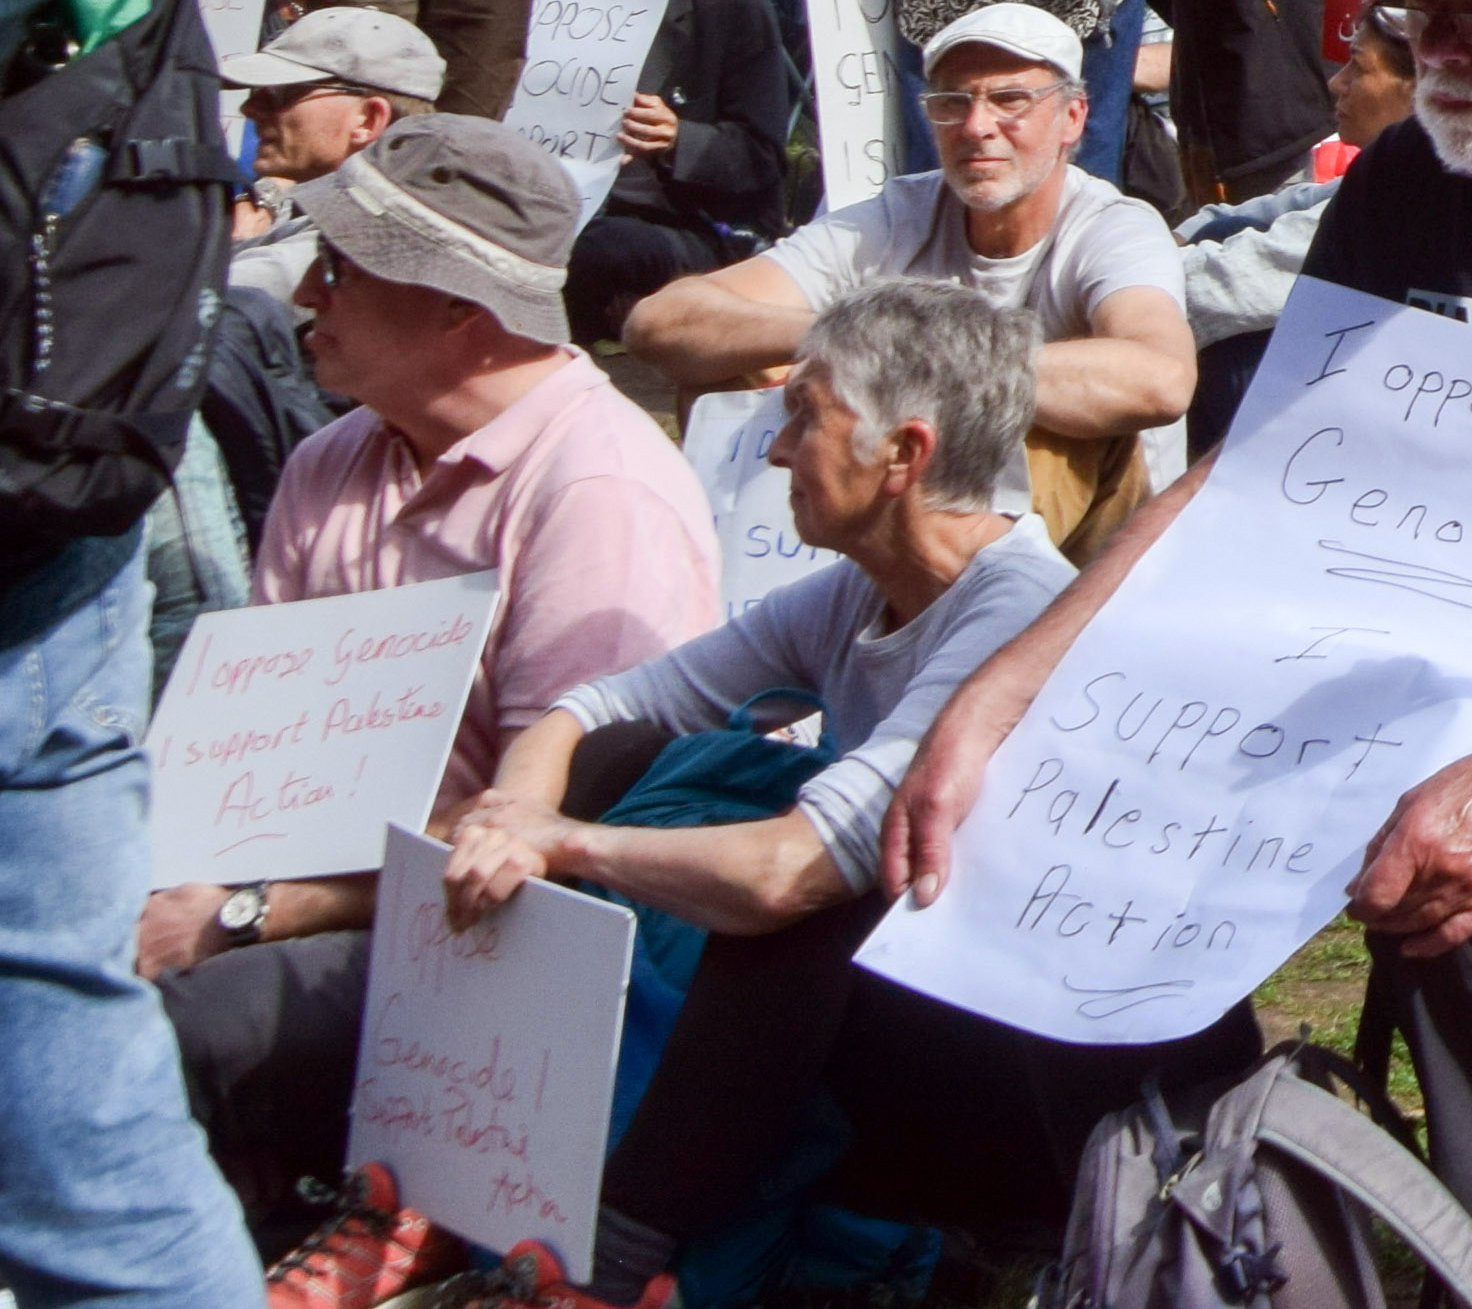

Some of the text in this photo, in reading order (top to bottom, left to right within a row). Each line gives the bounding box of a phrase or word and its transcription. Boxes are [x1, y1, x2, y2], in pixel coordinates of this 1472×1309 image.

[533, 0, 648, 43] PPOSE
[521, 57, 635, 107] OCIDE
[1306, 319, 1375, 387] I
[187, 633, 214, 696] I
[185, 711, 311, 767] support
[1005, 757, 1319, 876] Palestine
[1015, 862, 1240, 953] Action
